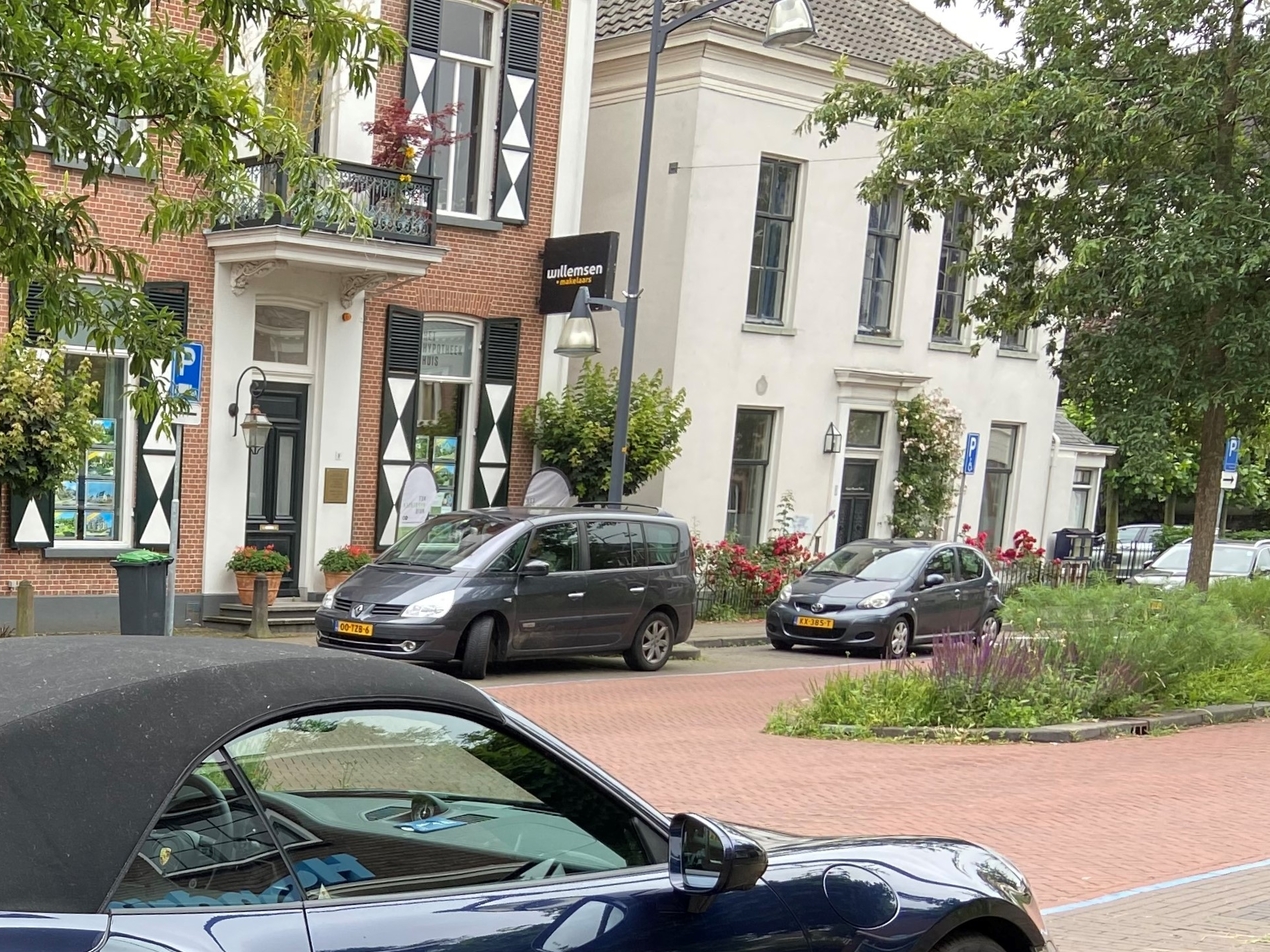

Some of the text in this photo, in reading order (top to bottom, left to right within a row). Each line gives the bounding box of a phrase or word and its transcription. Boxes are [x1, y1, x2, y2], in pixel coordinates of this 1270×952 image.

[546, 265, 603, 279] willemsen
[560, 277, 592, 286] makelaars
[421, 355, 439, 367] HUIS
[340, 623, 370, 634] 00-TZB-6
